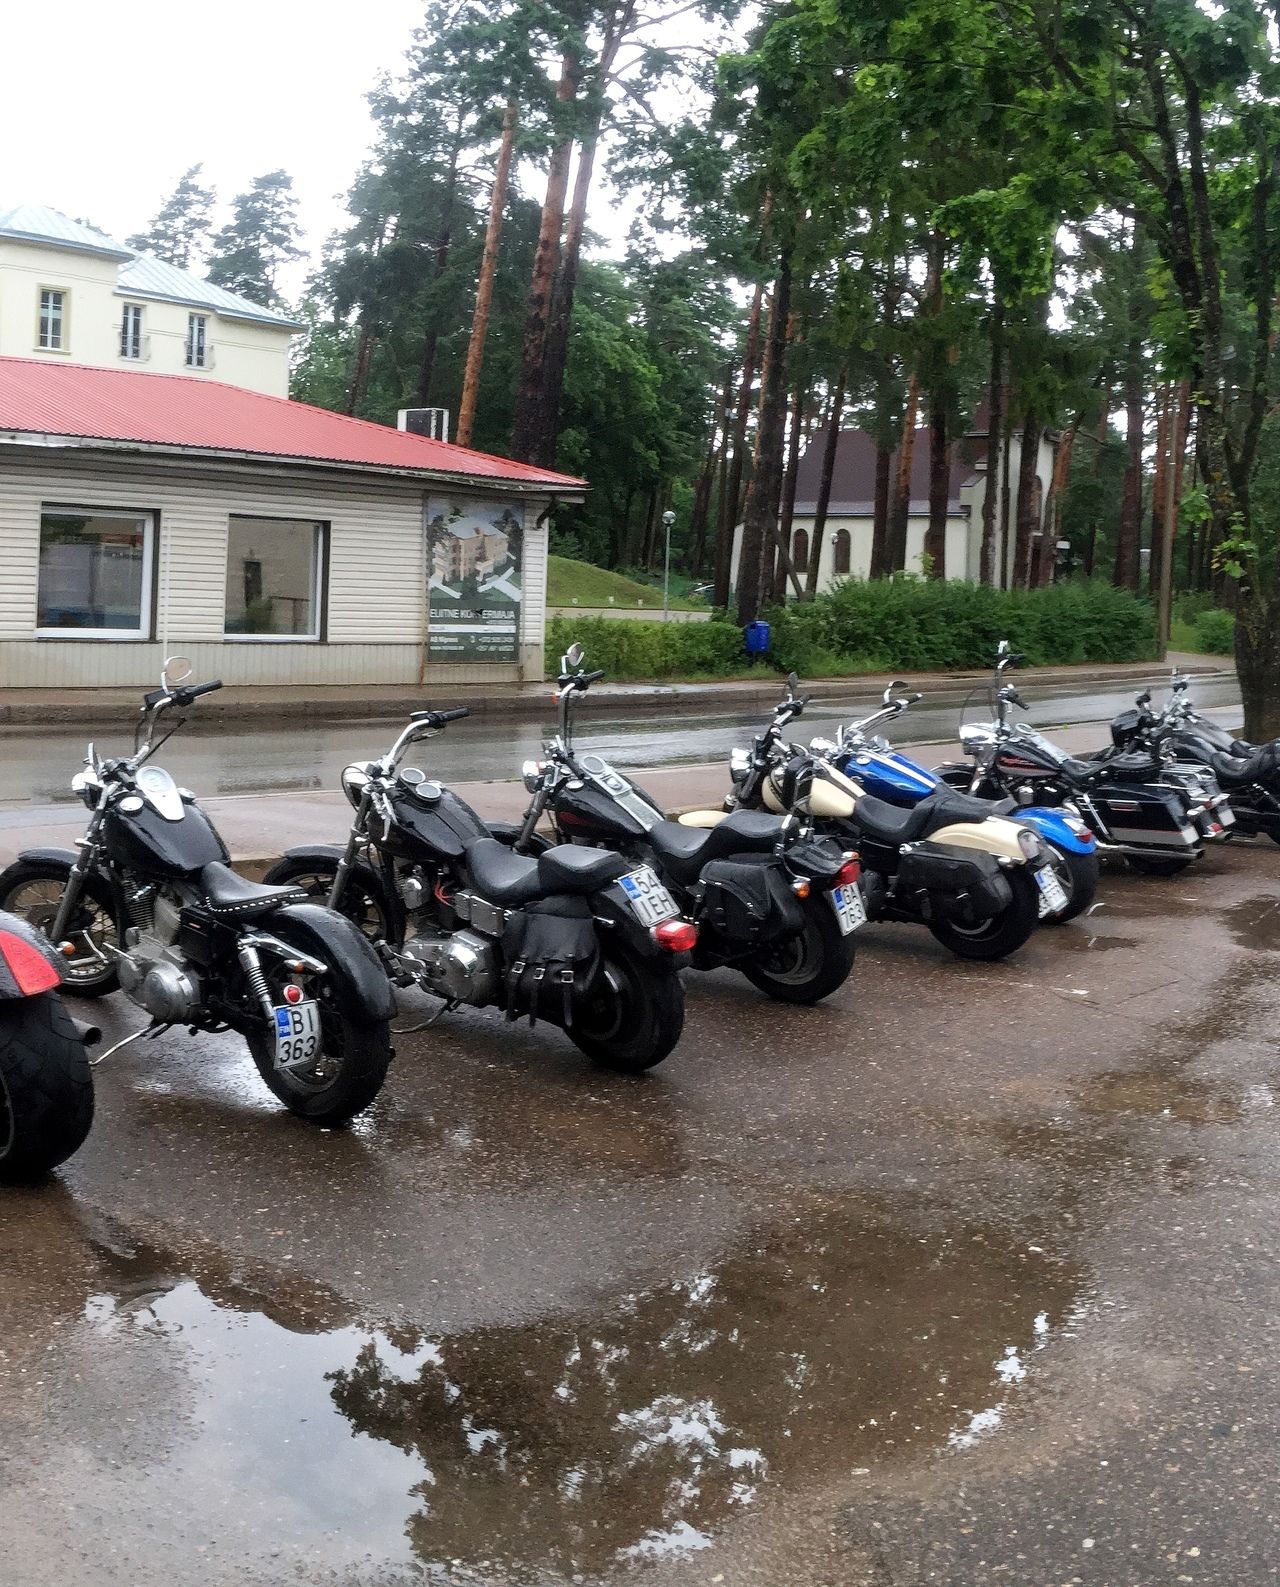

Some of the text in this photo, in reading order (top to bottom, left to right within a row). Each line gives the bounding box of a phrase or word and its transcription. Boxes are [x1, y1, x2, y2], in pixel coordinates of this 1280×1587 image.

[635, 872, 661, 894] 54
[641, 890, 675, 920] IEH
[841, 903, 863, 929] 763
[291, 1008, 314, 1036] BI
[279, 1035, 317, 1064] 363
